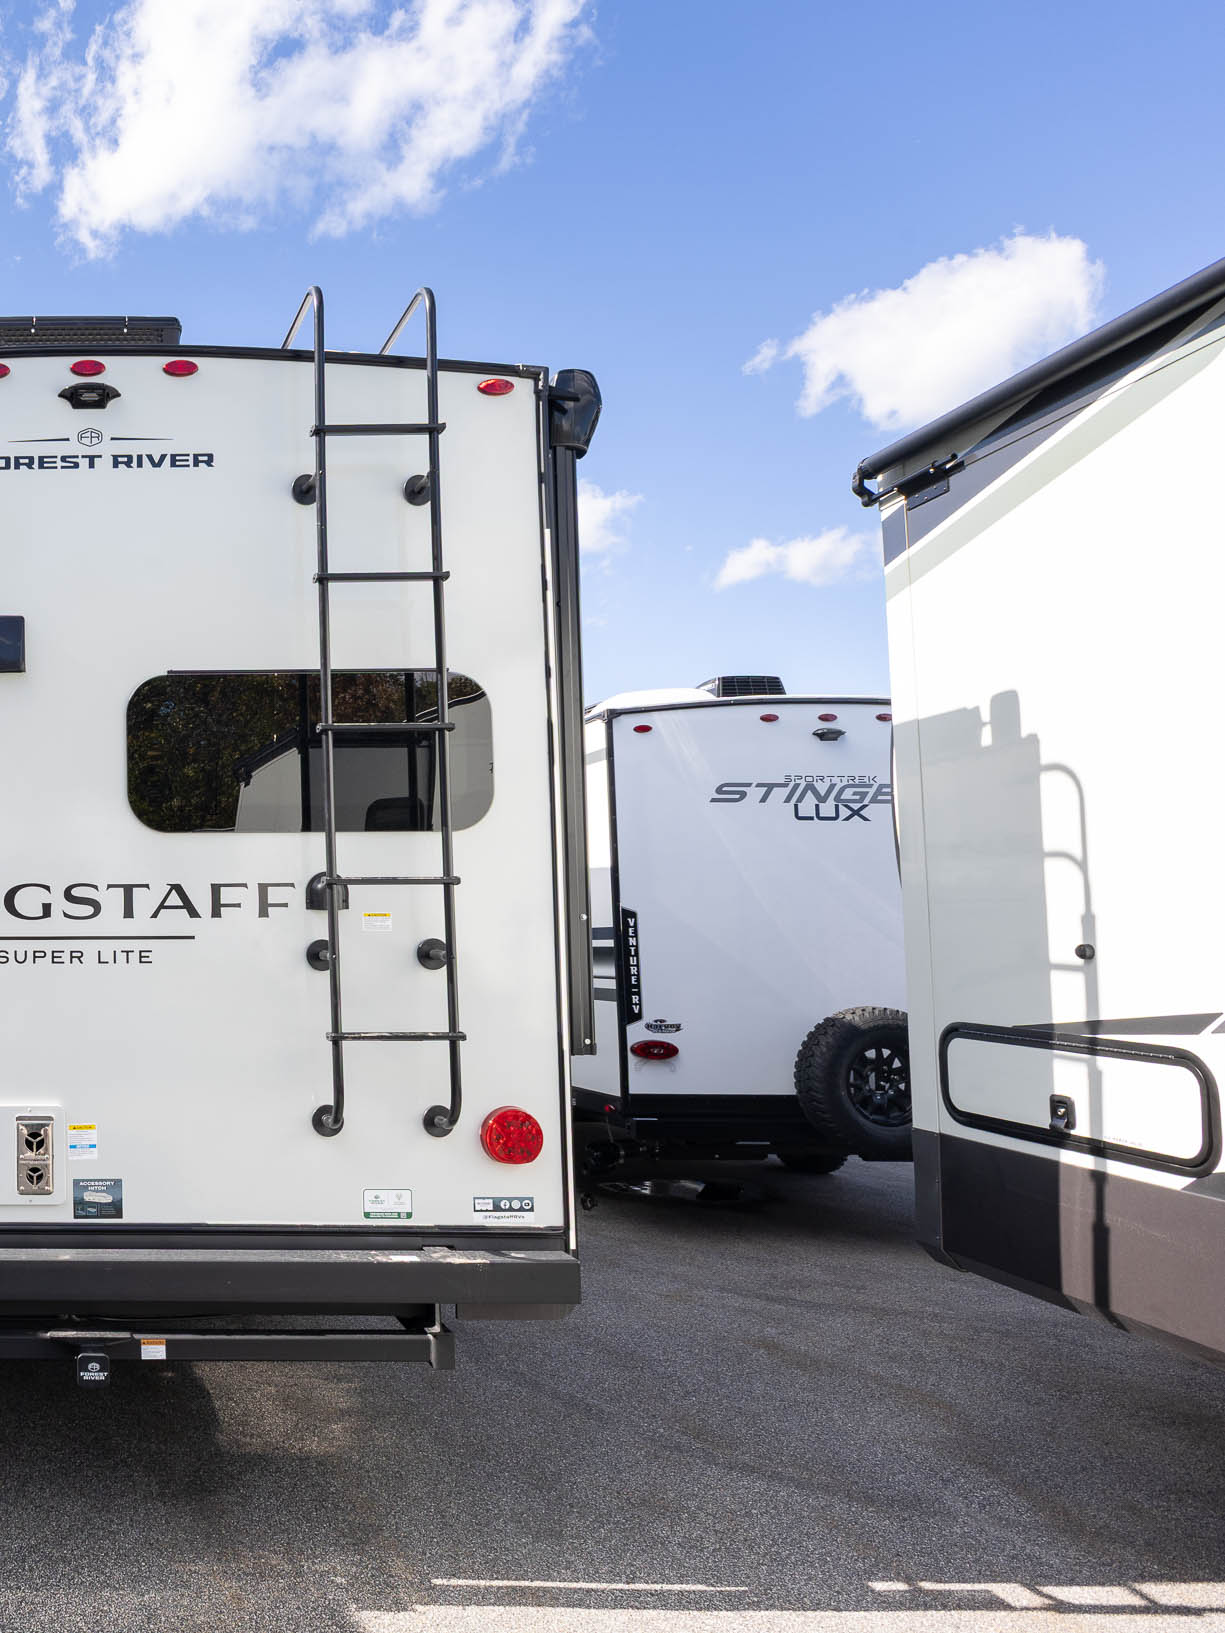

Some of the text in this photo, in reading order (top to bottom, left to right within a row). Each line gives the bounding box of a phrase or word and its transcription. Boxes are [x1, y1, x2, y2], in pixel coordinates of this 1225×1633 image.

[110, 452, 216, 469] RIVER
[783, 774, 878, 784] SPORTTREK
[709, 782, 894, 804] STINGE
[793, 804, 872, 822] LUX
[97, 949, 153, 965] LITE
